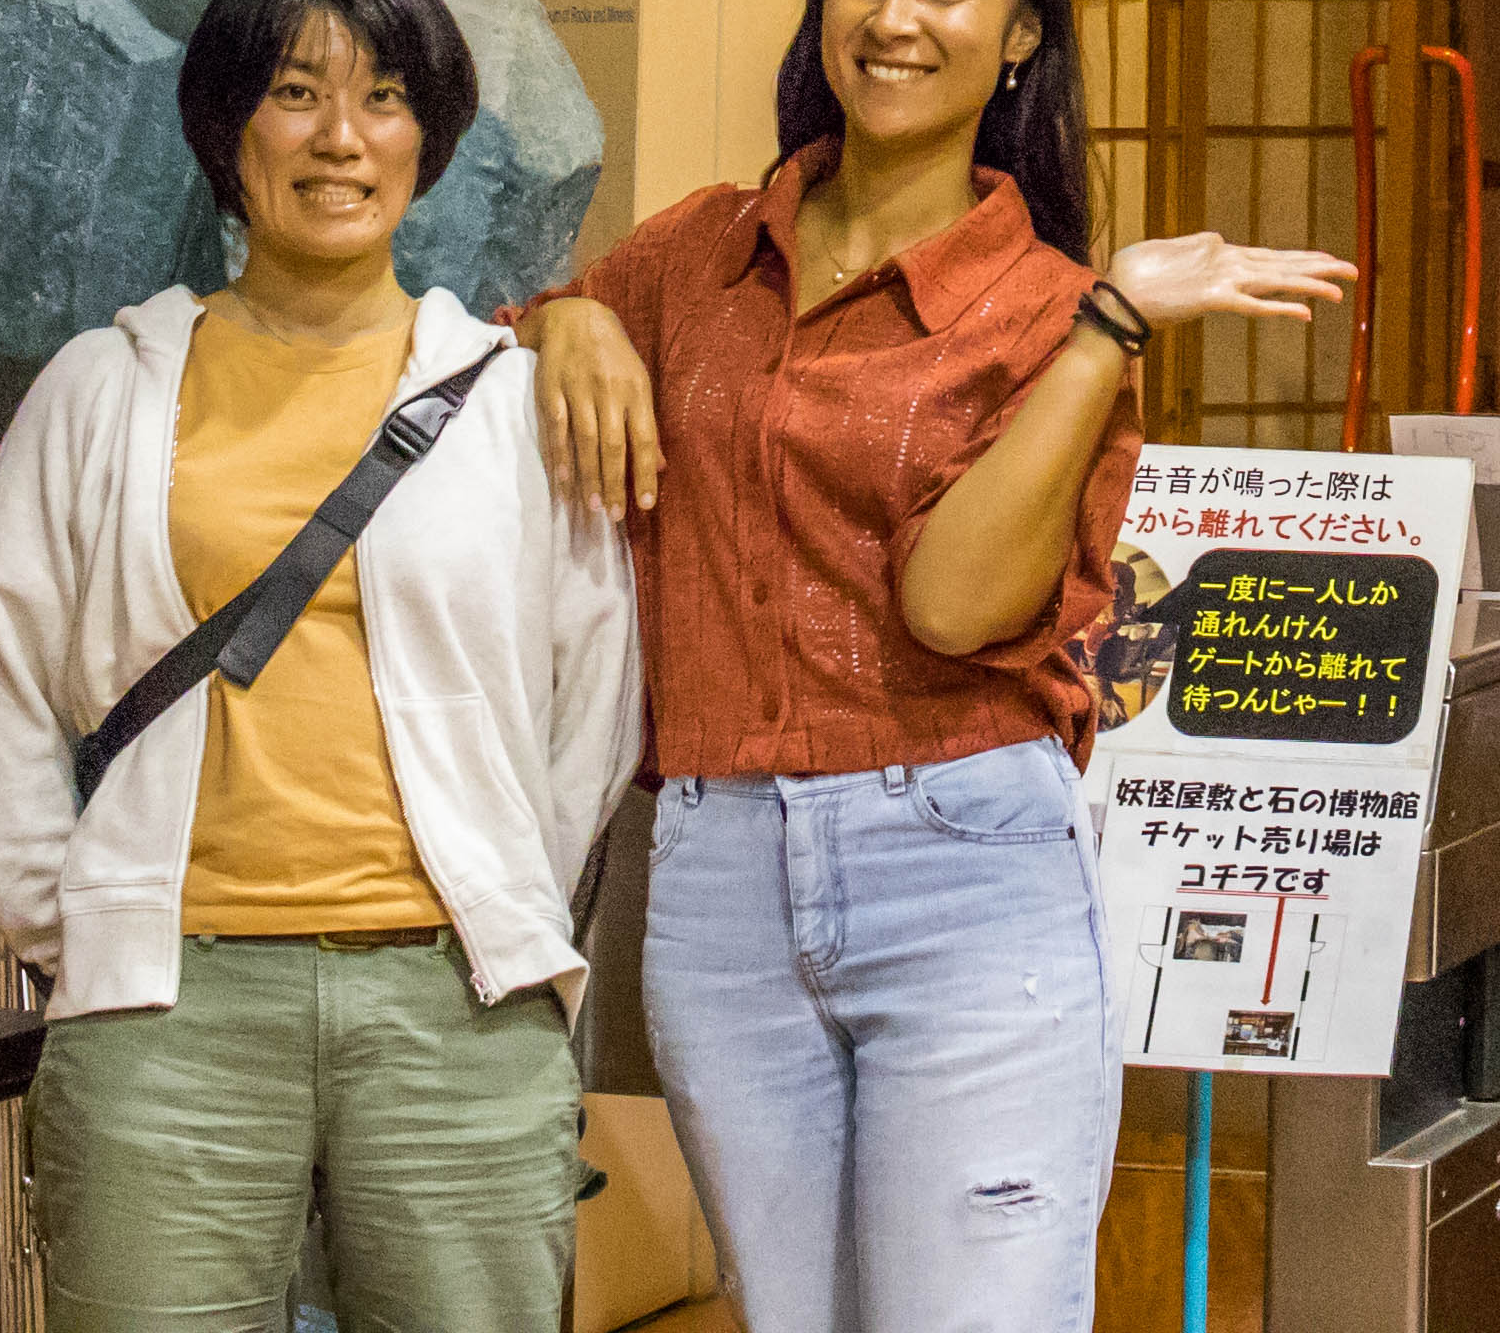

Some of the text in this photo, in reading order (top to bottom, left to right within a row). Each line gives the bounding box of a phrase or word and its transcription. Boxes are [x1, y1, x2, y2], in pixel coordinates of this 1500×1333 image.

[1199, 574, 1399, 606] 一度に一人しか
[1191, 609, 1339, 641] 通れんけん
[1186, 646, 1407, 681] ゲートから離れて
[1115, 777, 1421, 820] 妖怪屋敷と石の博物館
[1140, 820, 1382, 857] チケット売り場は
[1180, 864, 1331, 894] コチラです
